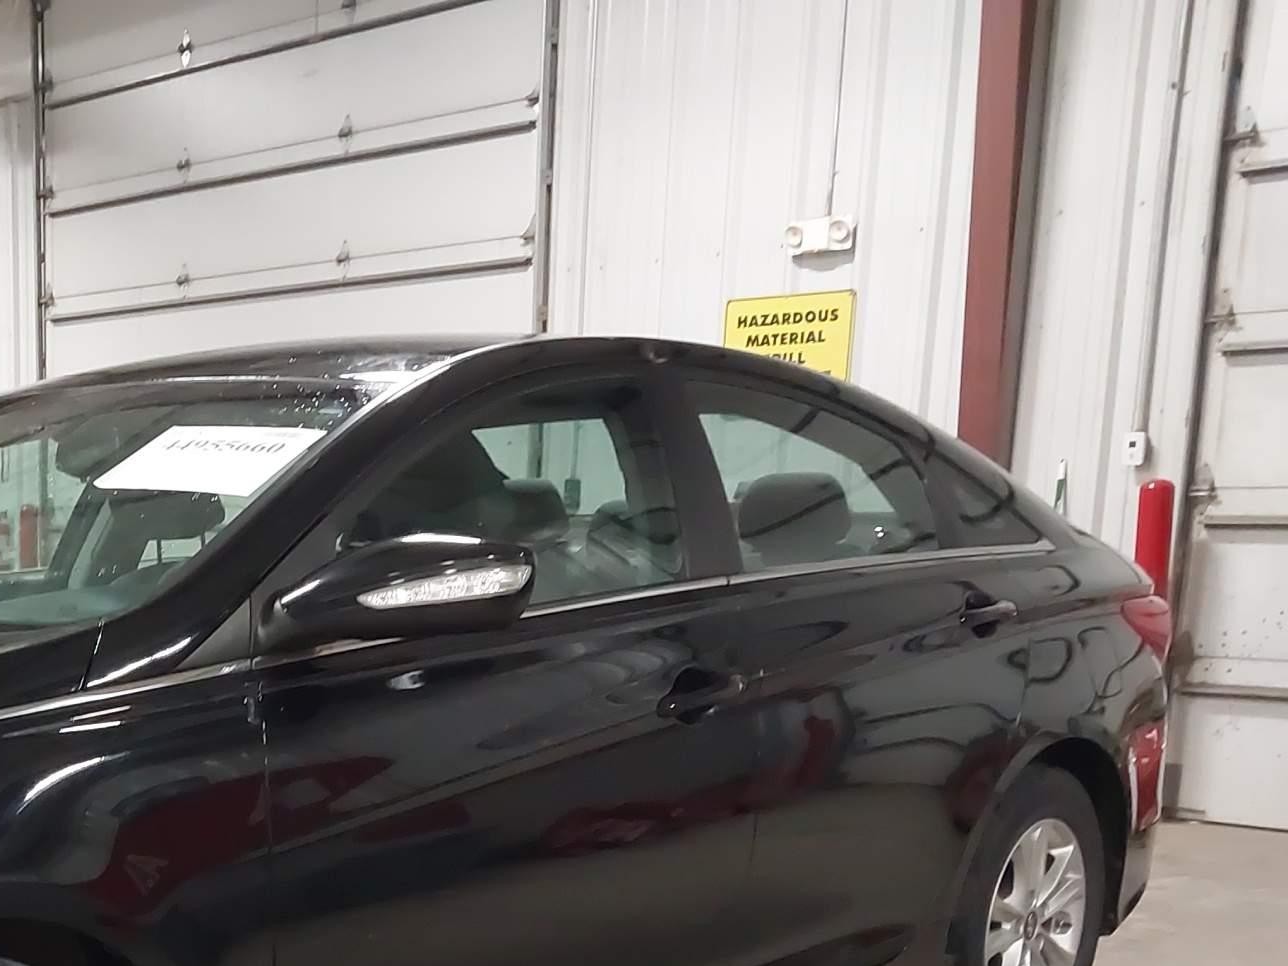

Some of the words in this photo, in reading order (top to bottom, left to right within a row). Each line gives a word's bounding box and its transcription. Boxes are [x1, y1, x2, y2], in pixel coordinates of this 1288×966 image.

[737, 308, 840, 329] HAZARDOUS
[745, 329, 827, 348] MATERIAL
[767, 351, 807, 364] PILL
